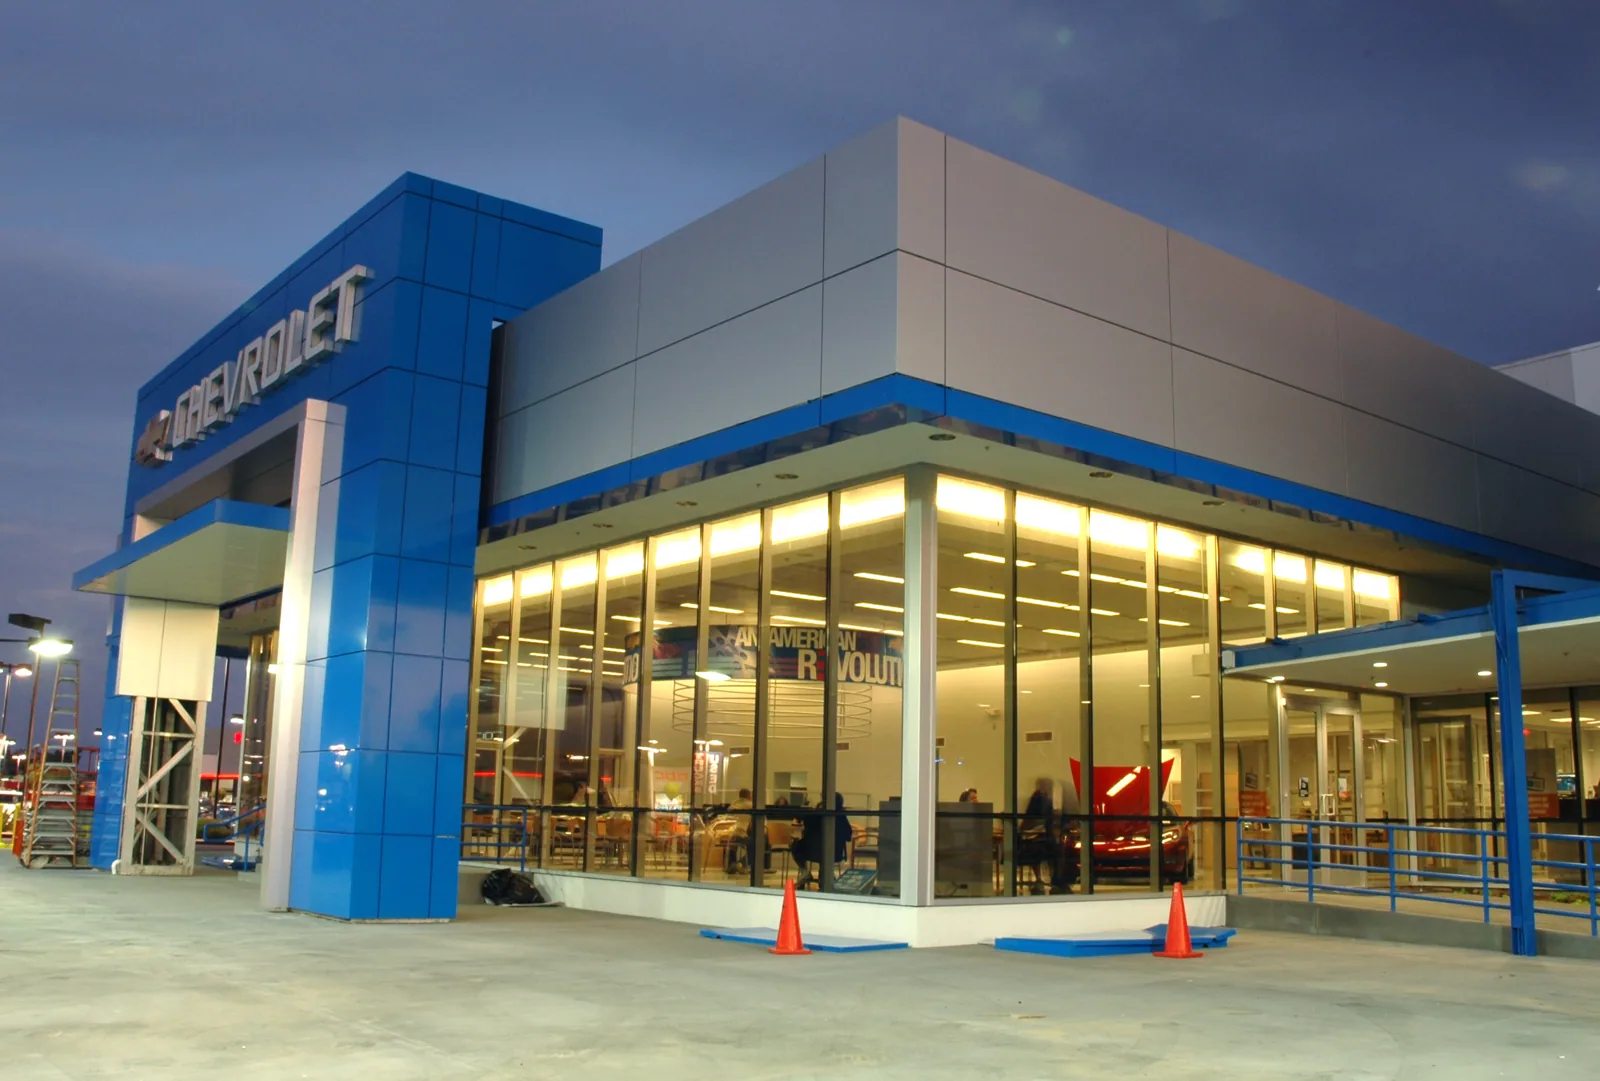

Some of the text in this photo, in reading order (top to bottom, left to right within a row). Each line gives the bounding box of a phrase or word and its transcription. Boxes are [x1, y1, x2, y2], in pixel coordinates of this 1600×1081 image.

[172, 264, 371, 449] CHEVROLET
[735, 626, 857, 651] AN AMERIAN
